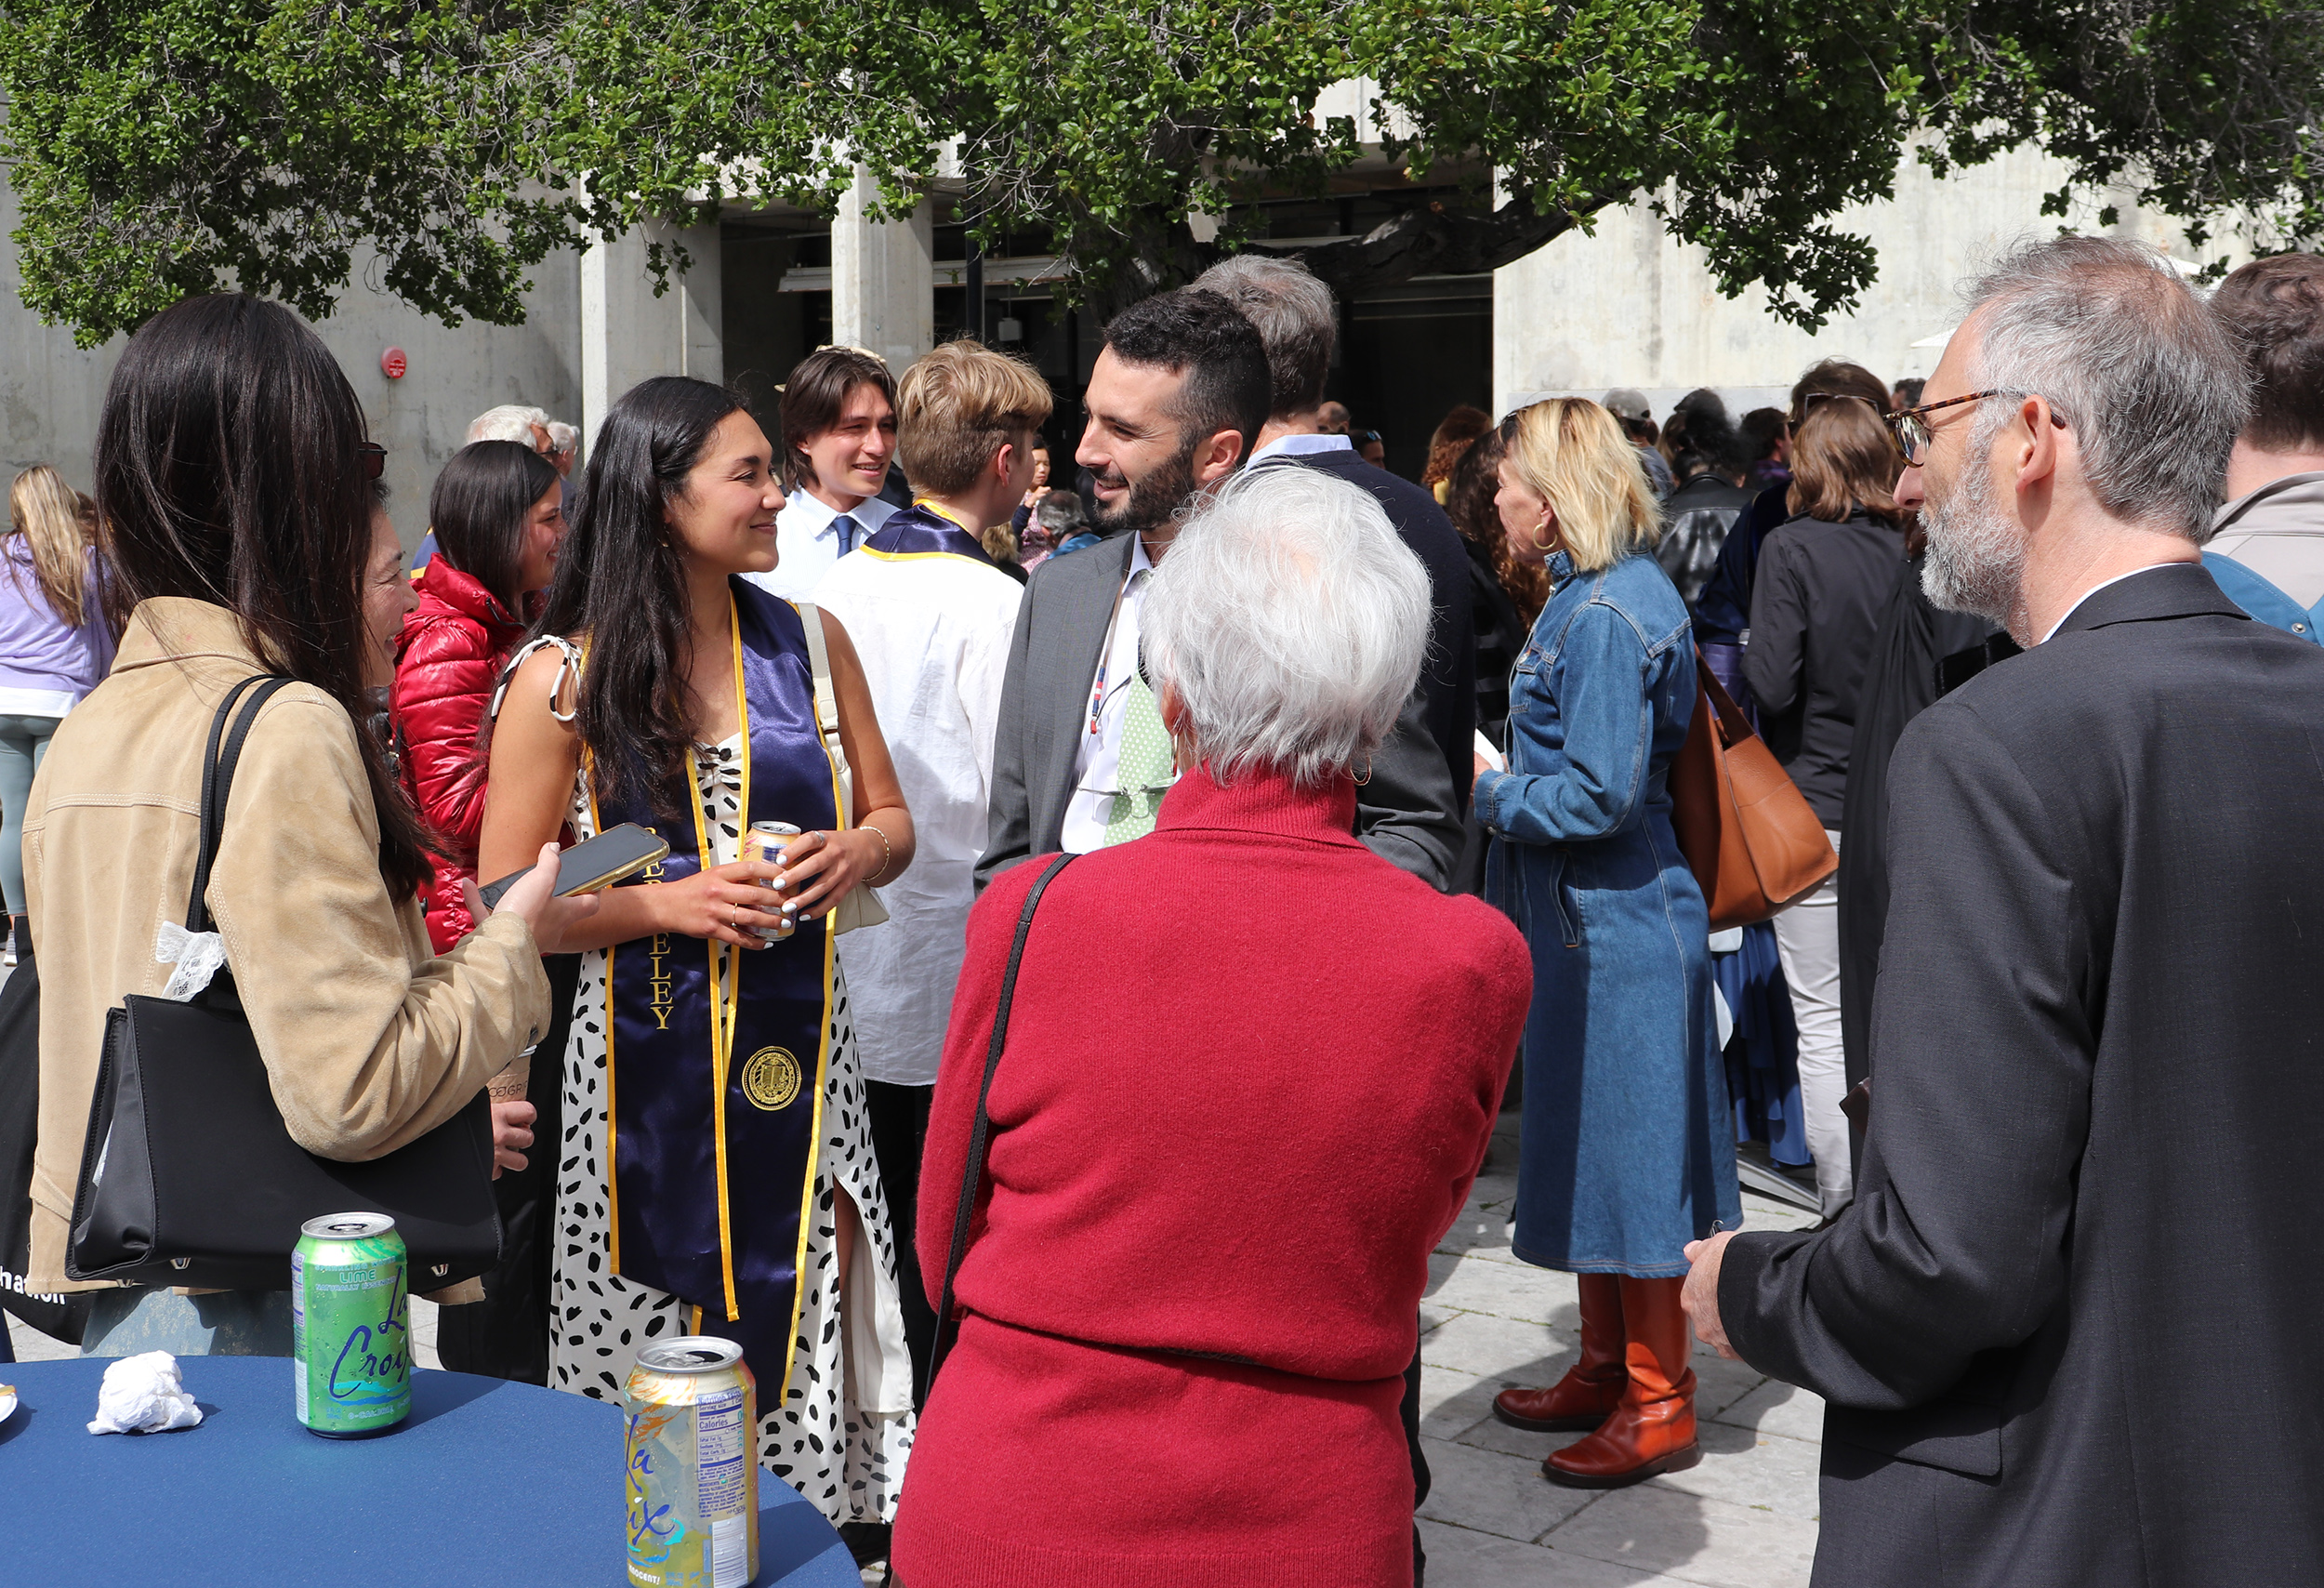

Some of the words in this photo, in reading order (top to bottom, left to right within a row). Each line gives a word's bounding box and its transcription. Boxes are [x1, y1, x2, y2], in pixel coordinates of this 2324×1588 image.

[642, 827, 675, 1030] EELEY
[315, 1263, 368, 1272] SPARKLING
[339, 1269, 376, 1284] LIME
[315, 1283, 360, 1292] NATURALLY
[698, 1395, 726, 1405] Nutrition
[727, 1391, 742, 1400] Facts
[699, 1419, 729, 1430] Calories
